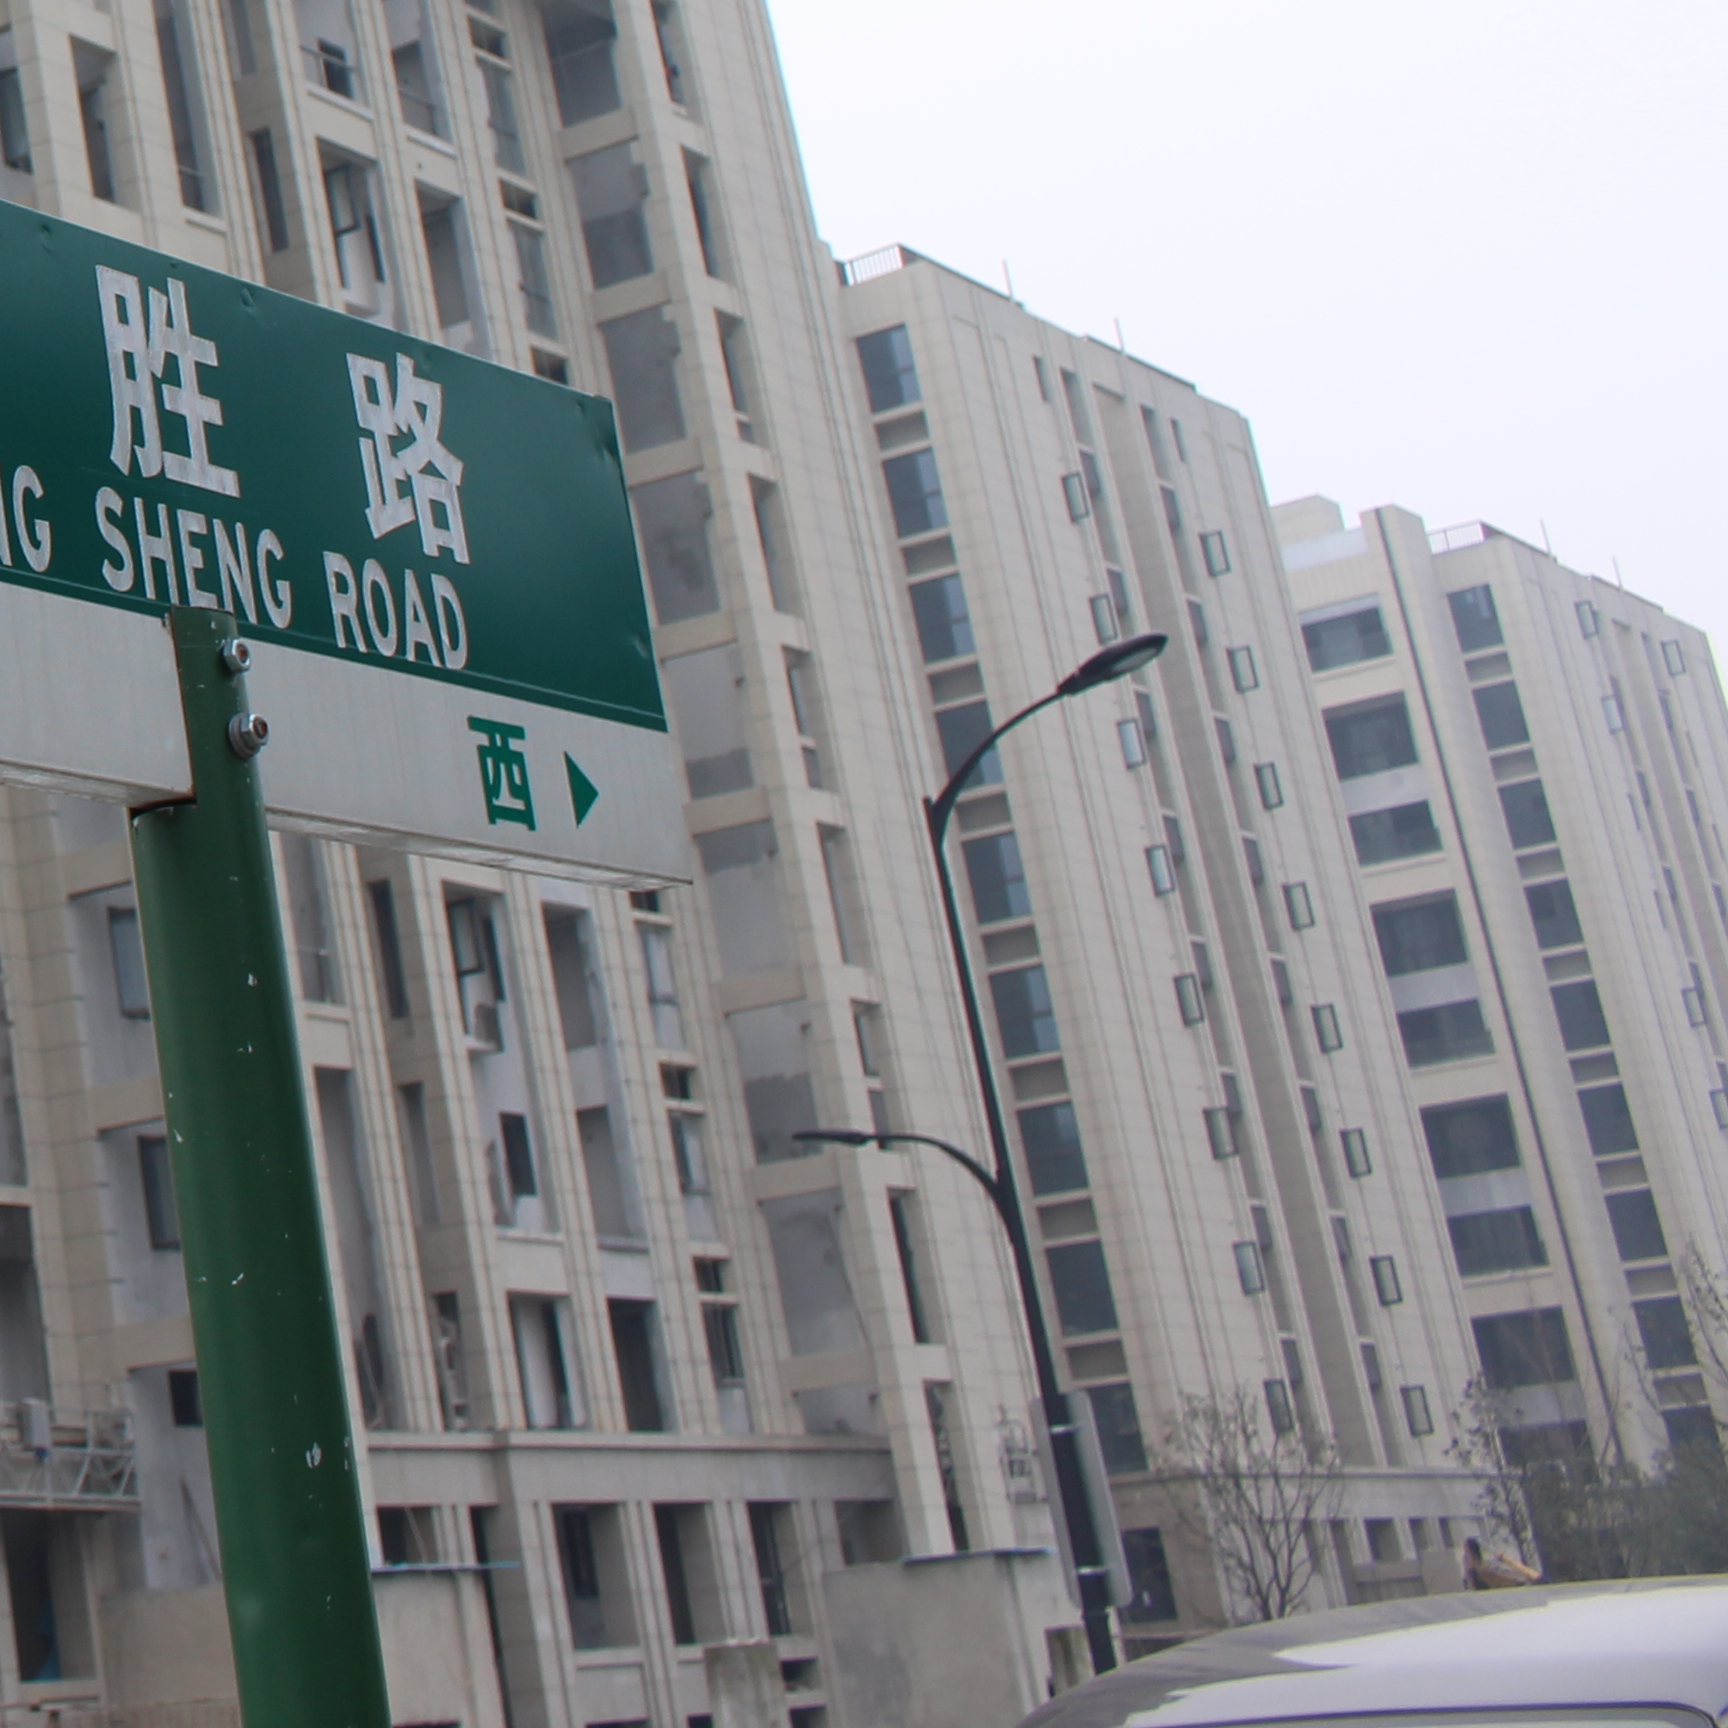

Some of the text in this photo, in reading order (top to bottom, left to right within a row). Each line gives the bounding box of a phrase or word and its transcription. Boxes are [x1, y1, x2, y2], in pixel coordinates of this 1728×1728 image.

[96, 487, 292, 628] SHENG
[324, 552, 467, 670] ROAD
[468, 715, 537, 832] 西
